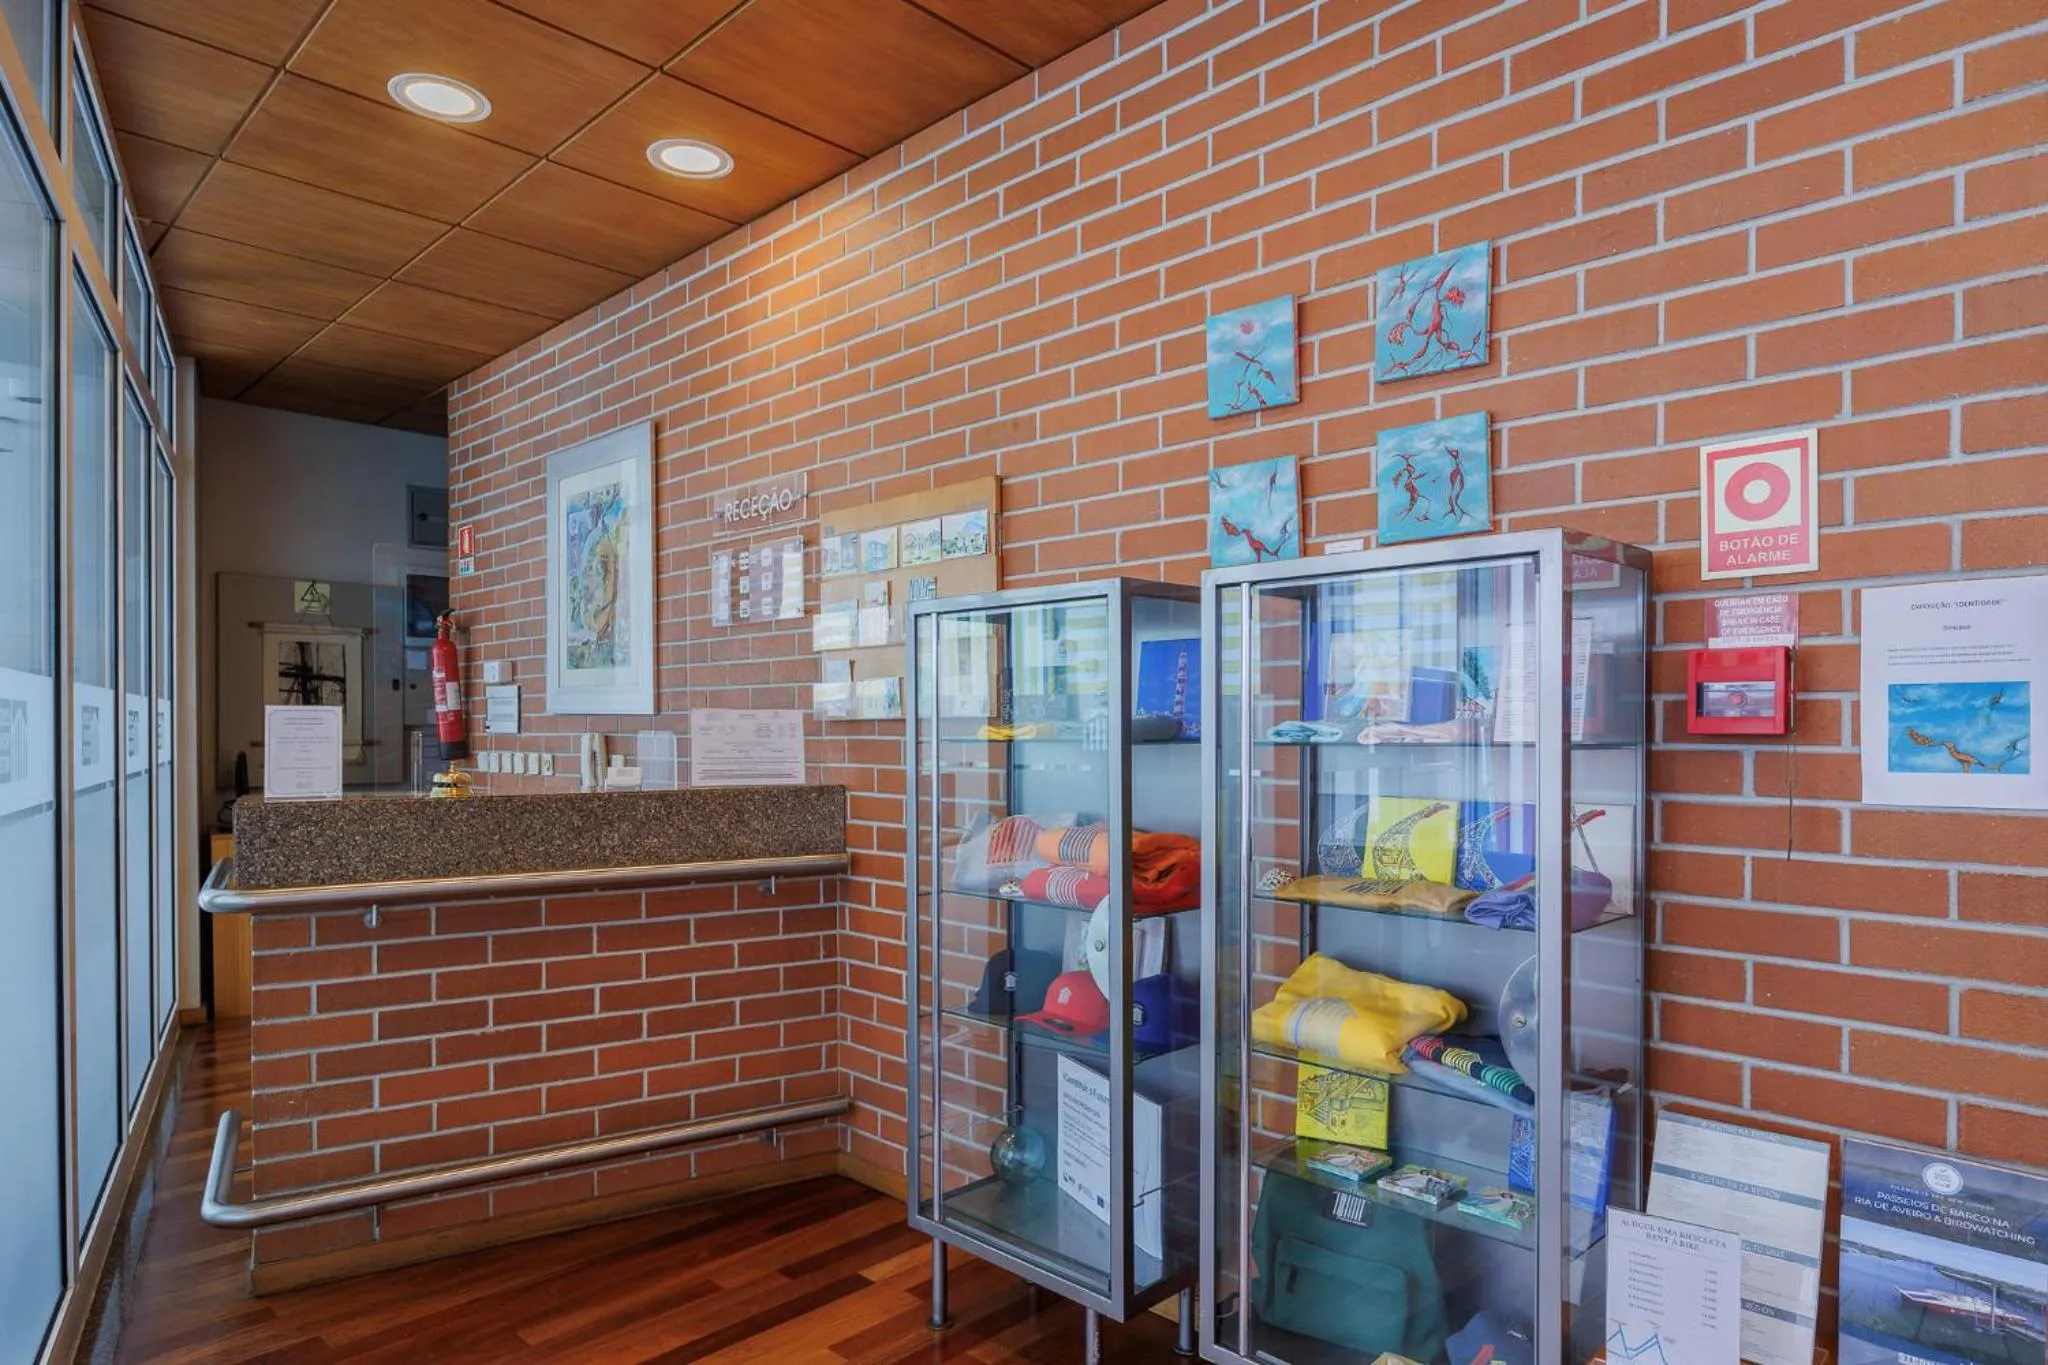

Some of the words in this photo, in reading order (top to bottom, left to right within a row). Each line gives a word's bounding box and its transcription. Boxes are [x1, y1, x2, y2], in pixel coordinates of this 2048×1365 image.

[724, 486, 792, 522] RECEÇÃO
[1719, 533, 1774, 552] BOTÃO
[1778, 532, 1800, 545] DE
[1726, 549, 1792, 567] ALARME
[1759, 615, 1781, 624] CASE
[1877, 1191, 1929, 1211] PASSEIOS
[1931, 1202, 1948, 1214] DE
[1949, 1207, 1990, 1224] BARCO
[1993, 1217, 2010, 1229] NA
[1854, 1196, 1872, 1209] RIA
[1874, 1201, 1889, 1212] DE
[1891, 1204, 1932, 1221] AVEIRO
[1934, 1214, 1943, 1223] &
[1943, 1217, 2036, 1246] BIRDWATCHING
[1645, 1232, 1668, 1244] RENT
[1679, 1239, 1700, 1251] BIKE
